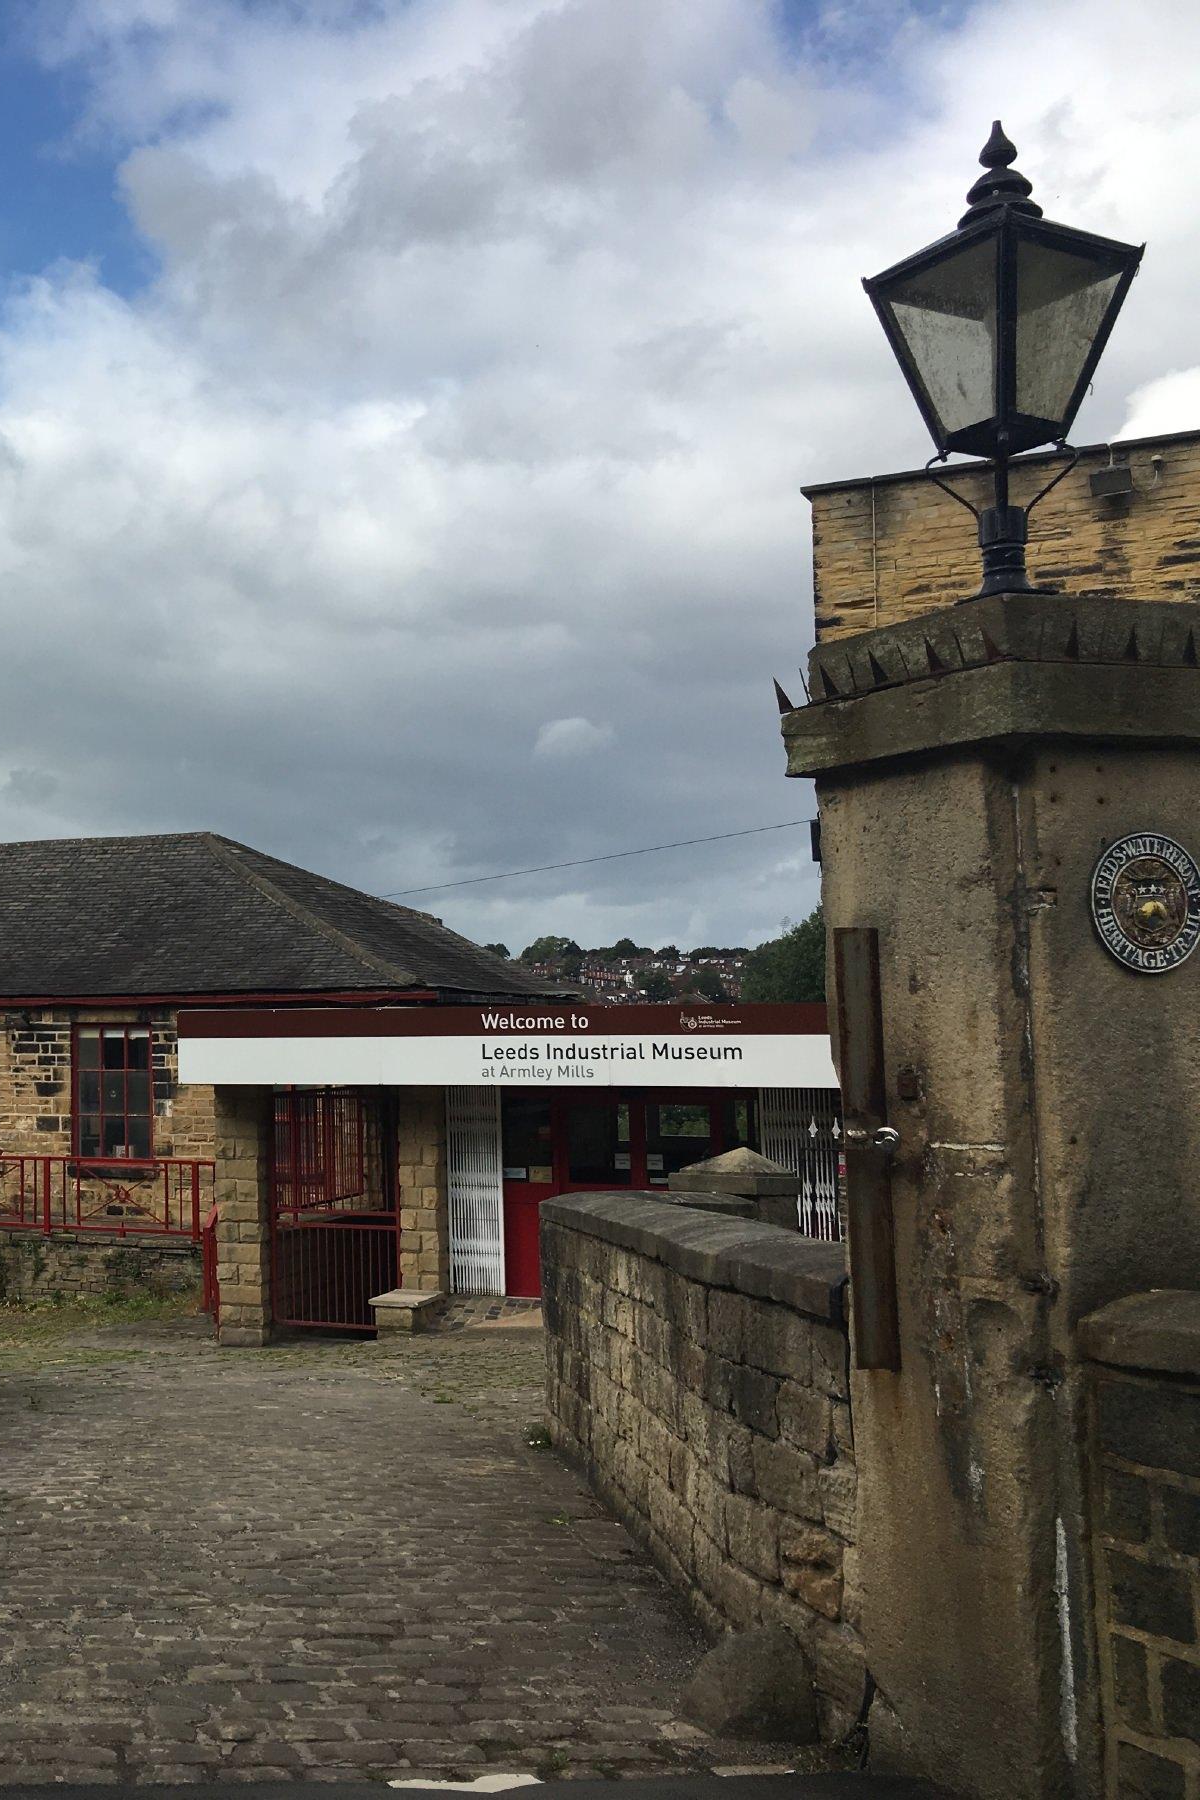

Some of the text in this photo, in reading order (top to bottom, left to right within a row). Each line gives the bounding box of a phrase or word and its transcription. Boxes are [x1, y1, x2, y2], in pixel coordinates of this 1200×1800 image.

[1097, 837, 1200, 899] LEEDS WATERFRONT
[1097, 908, 1200, 968] HERITAGE TRAIL
[481, 1013, 589, 1030] Welcome to
[481, 1042, 743, 1060] Leeds Industrial Museum
[481, 1064, 595, 1082] at Armley Mills
